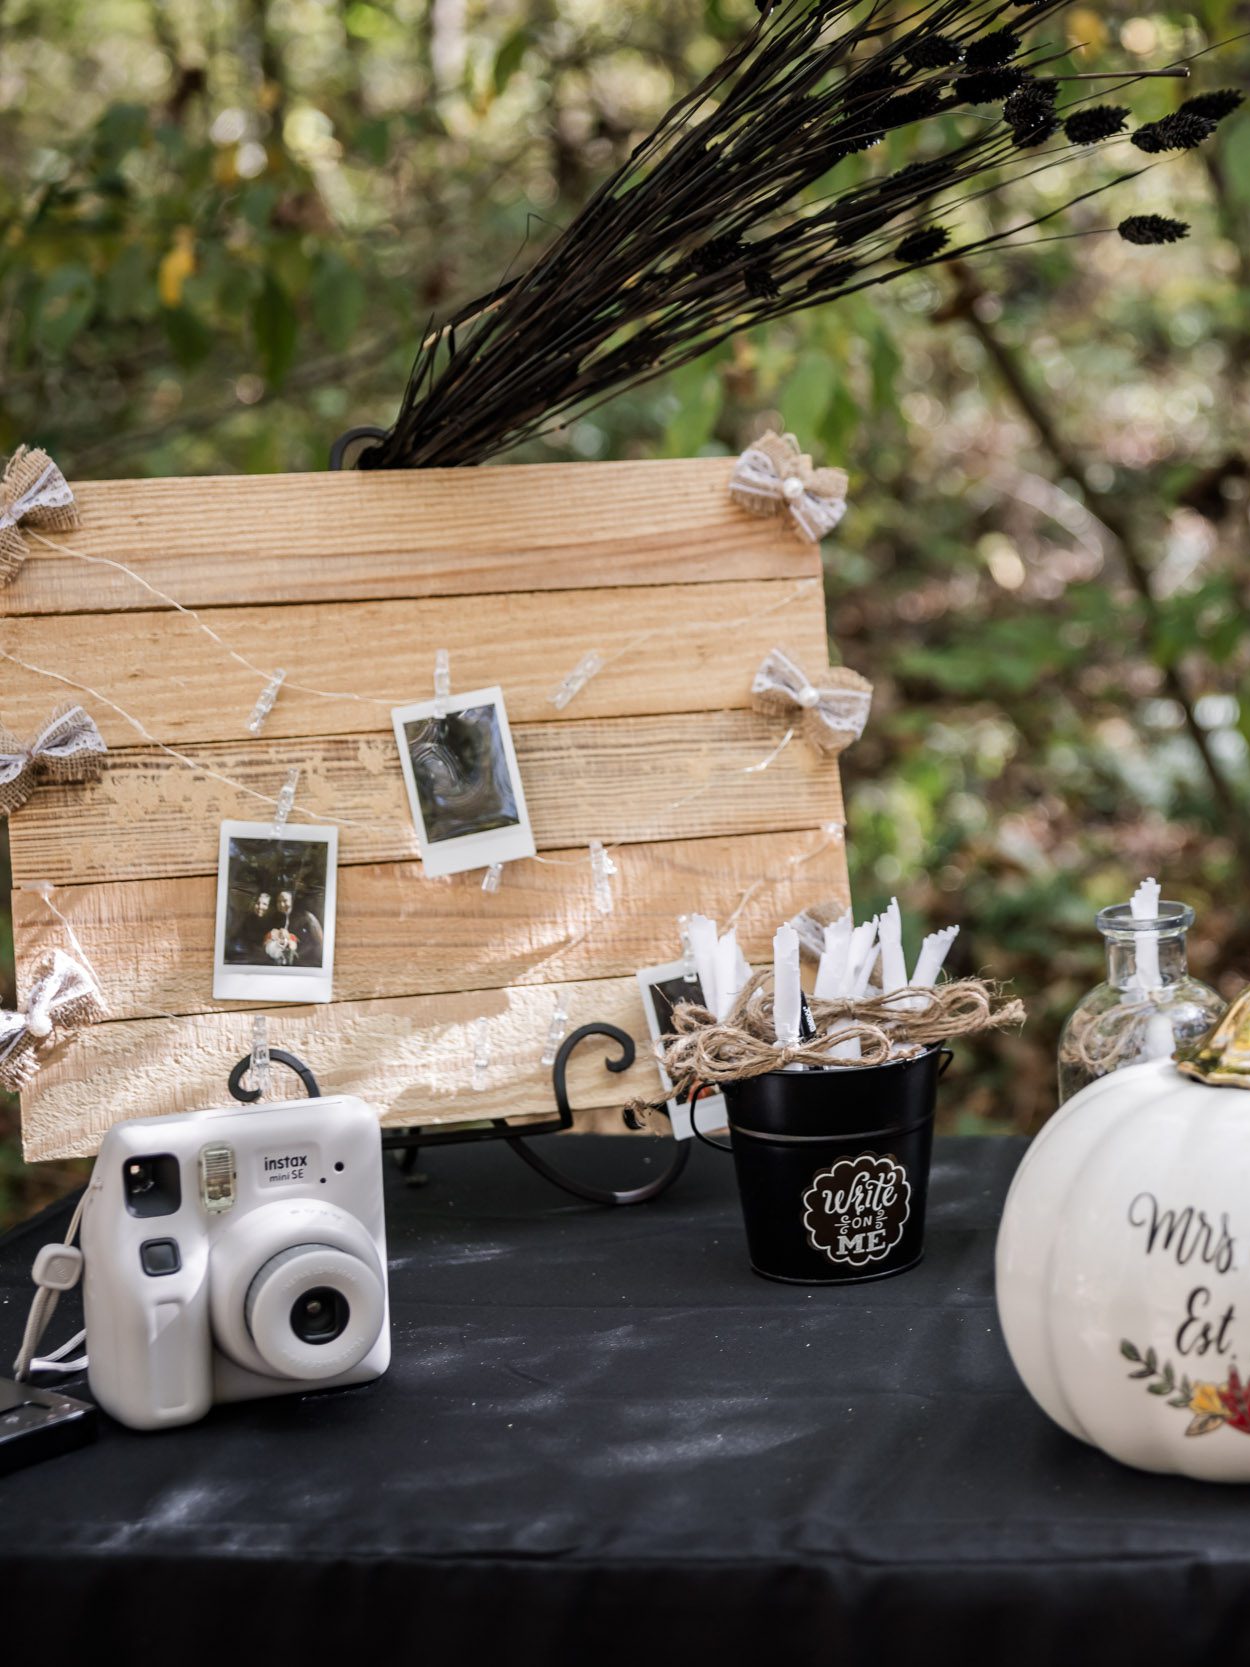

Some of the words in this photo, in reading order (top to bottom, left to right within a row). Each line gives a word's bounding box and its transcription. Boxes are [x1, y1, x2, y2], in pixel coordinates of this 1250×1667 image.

[264, 1154, 308, 1171] instax
[269, 1172, 290, 1182] mini
[291, 1168, 304, 1180] SE
[821, 1171, 898, 1216] Write
[852, 1215, 873, 1229] ON
[836, 1228, 887, 1256] ME
